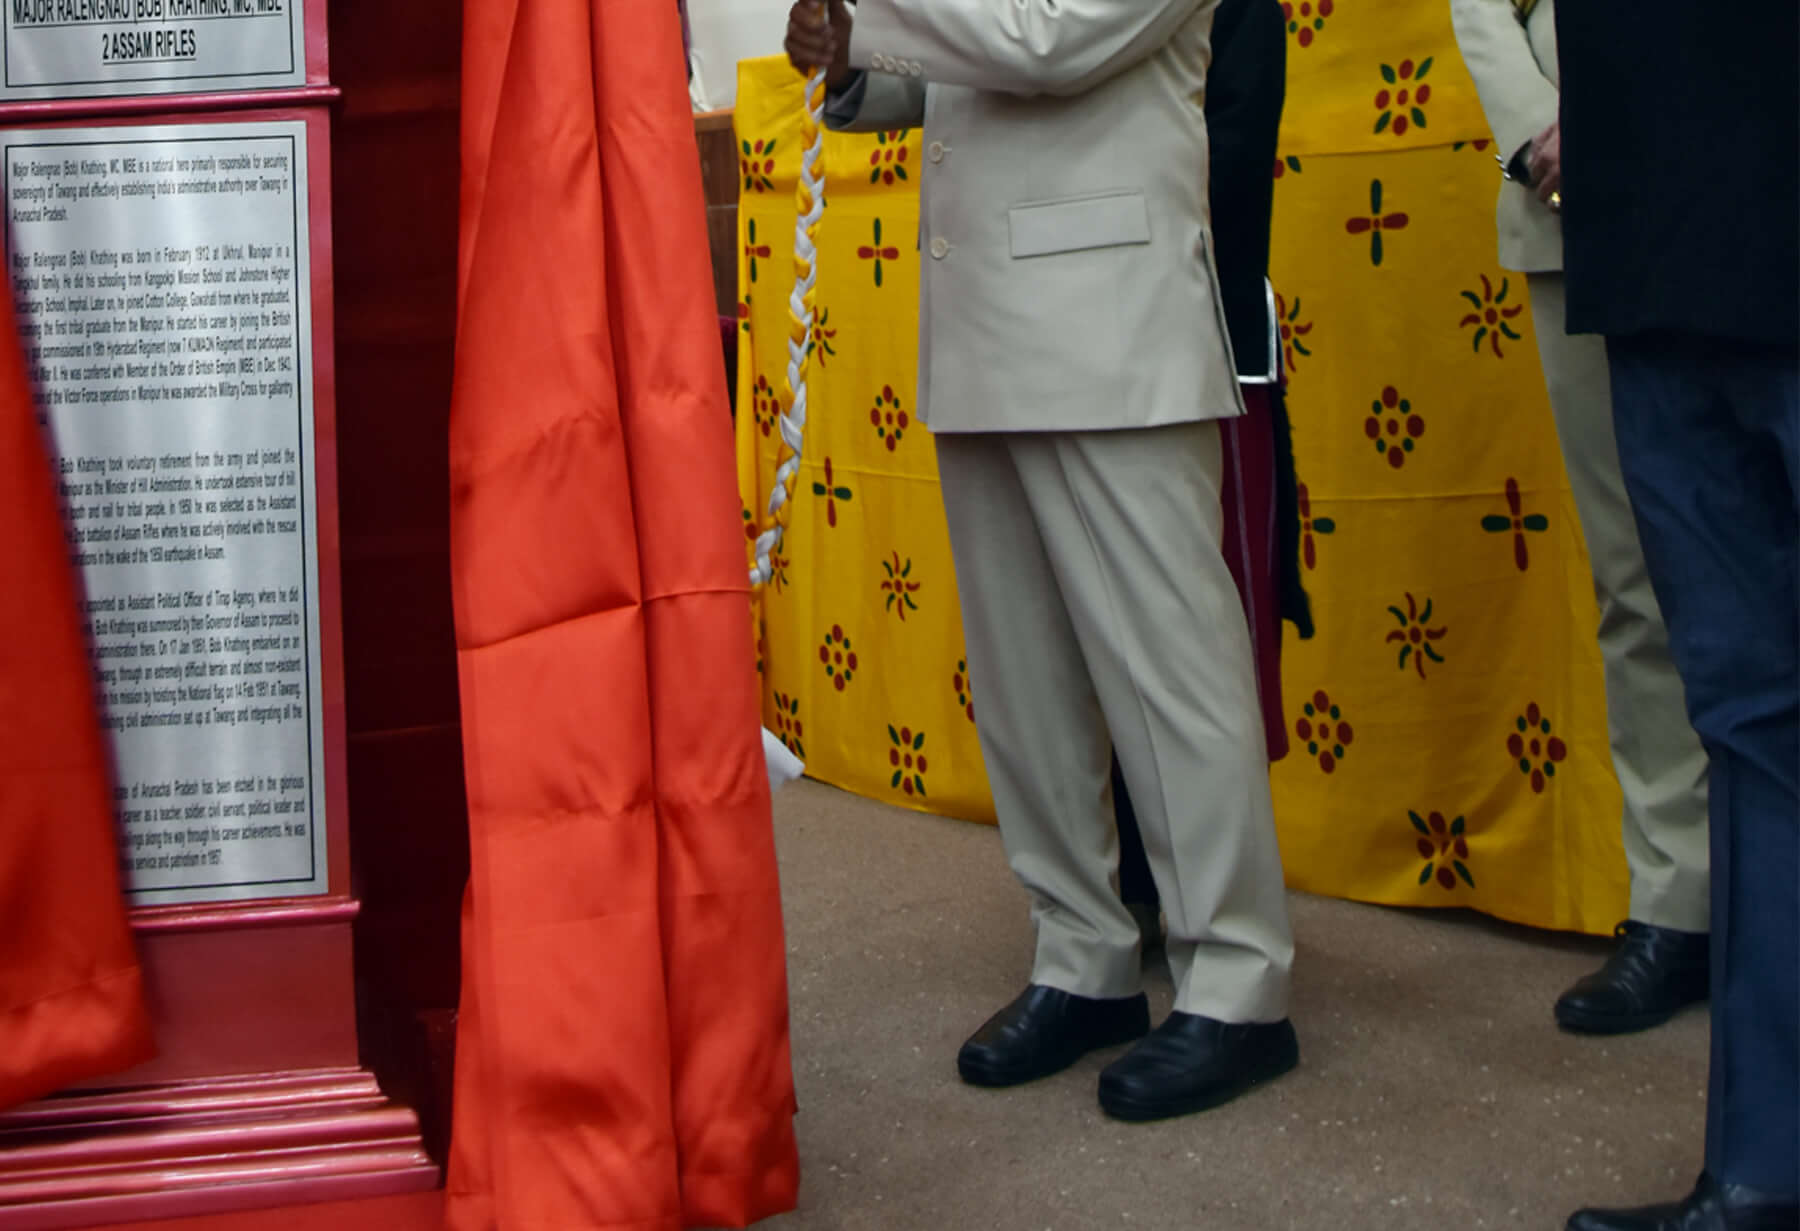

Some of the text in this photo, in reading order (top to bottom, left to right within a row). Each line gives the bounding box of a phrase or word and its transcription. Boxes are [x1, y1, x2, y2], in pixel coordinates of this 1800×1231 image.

[102, 29, 196, 60] 2 ASSAM RIFLES
